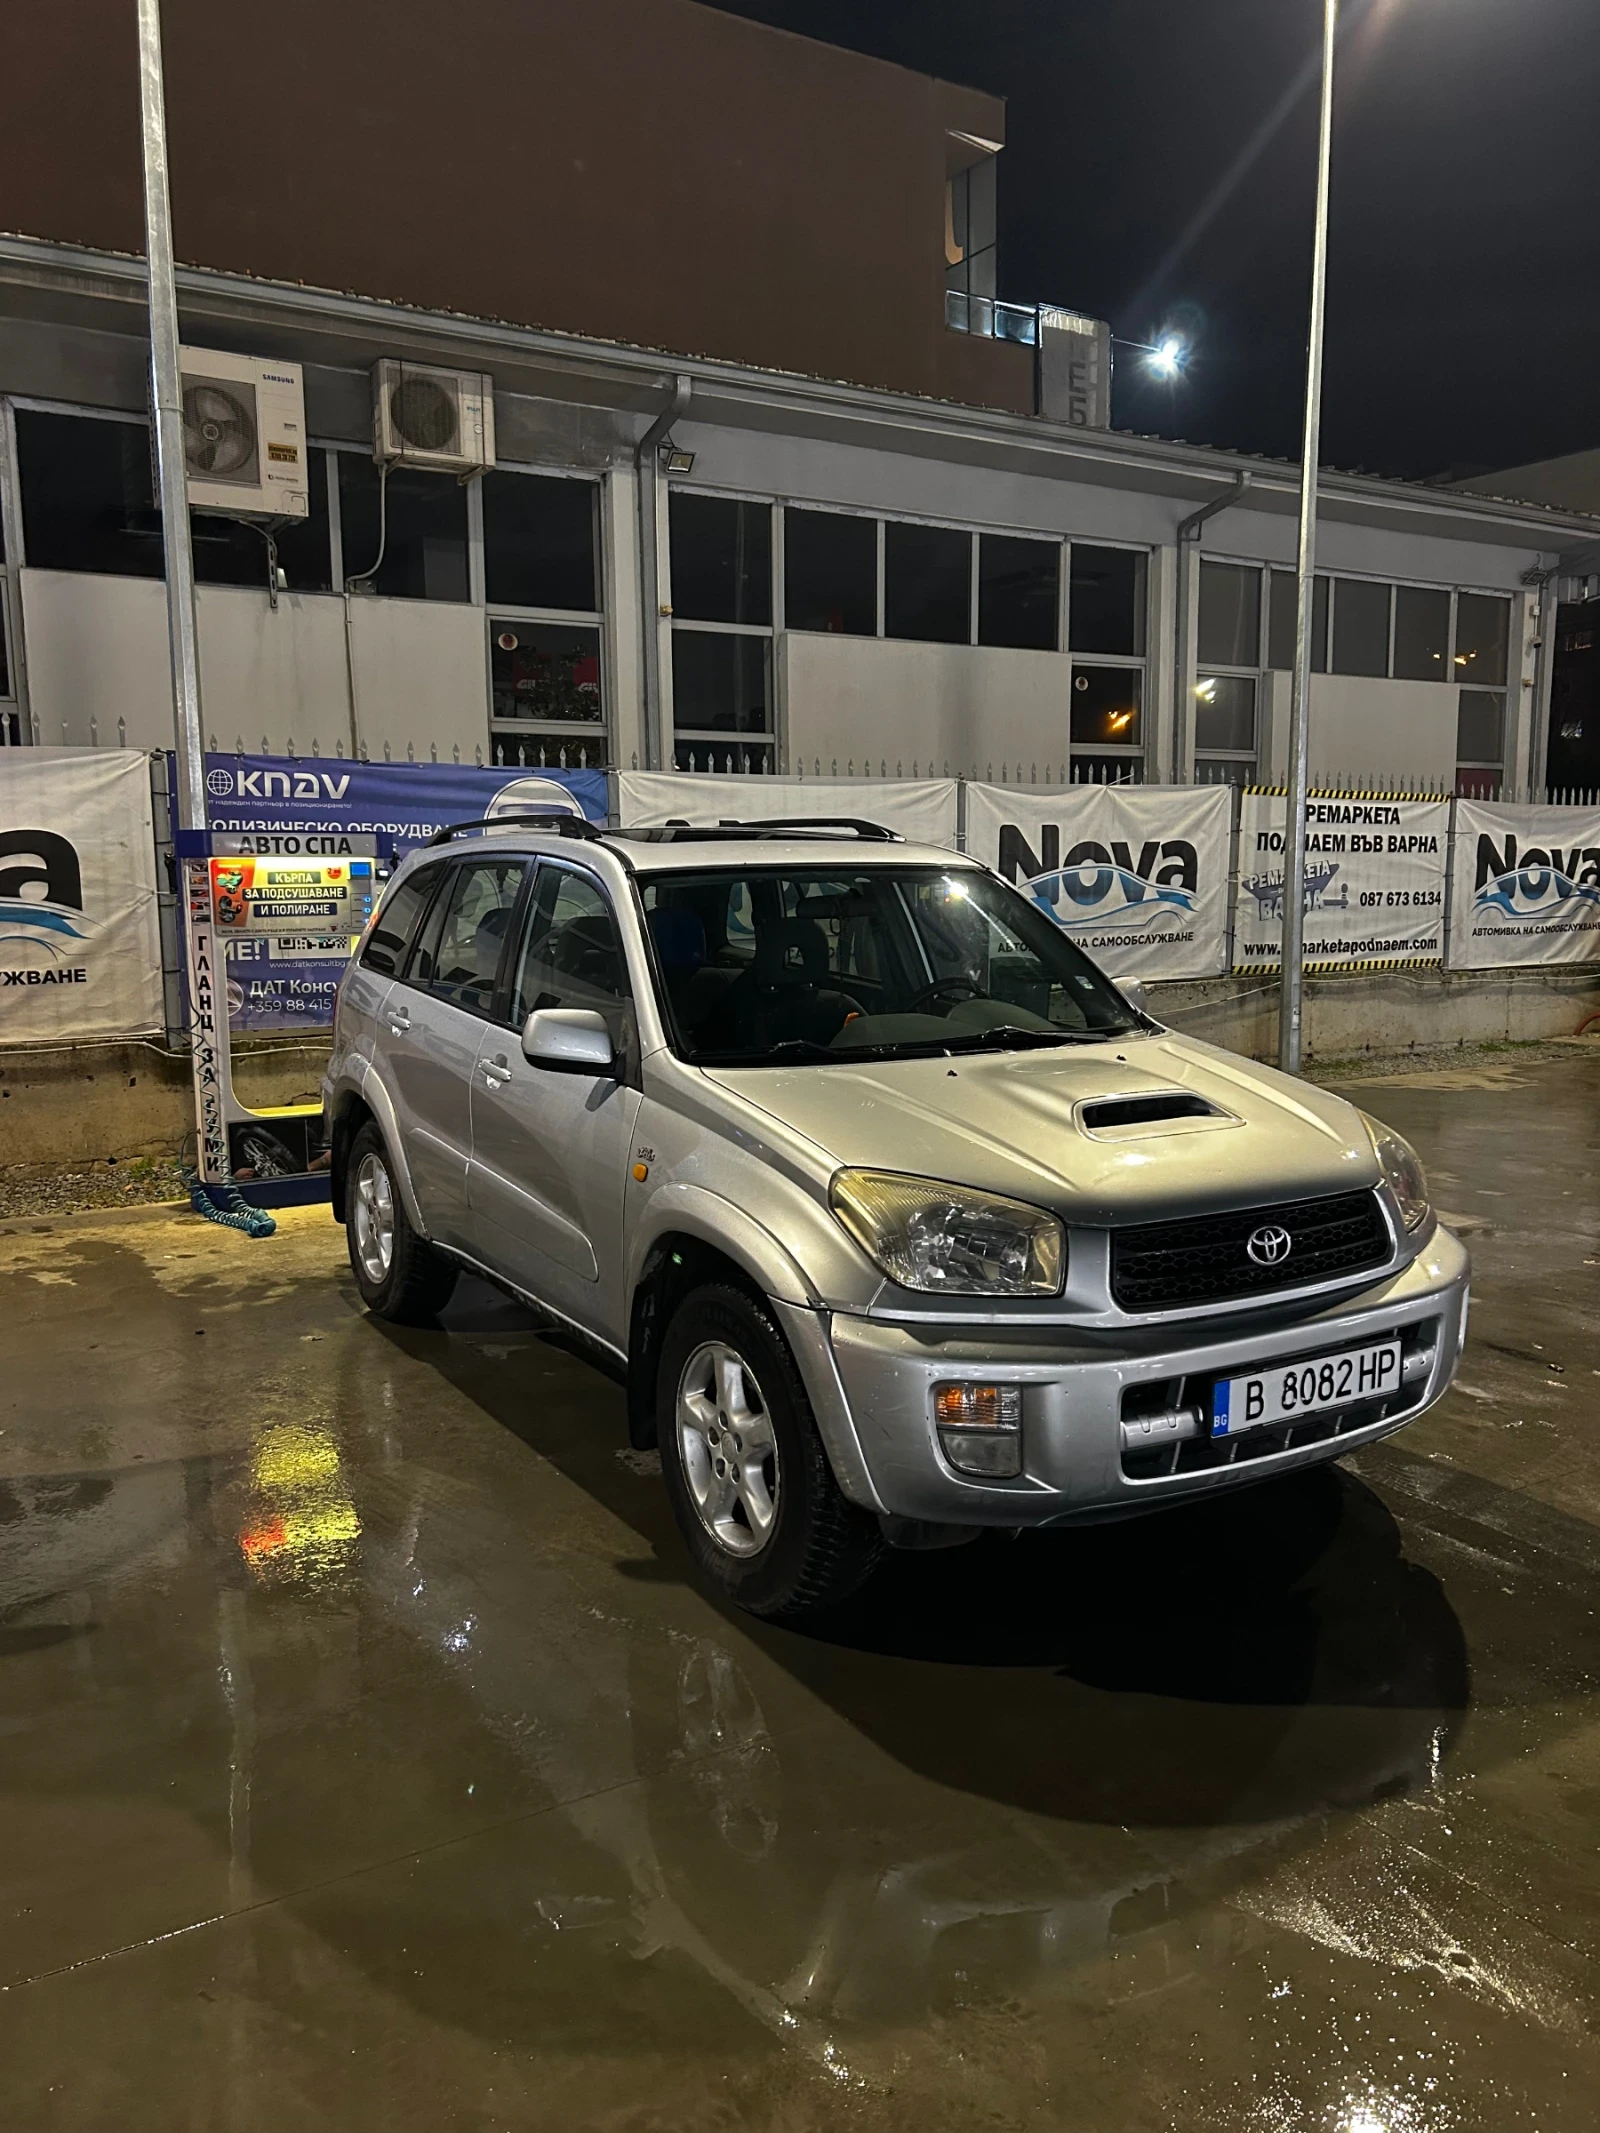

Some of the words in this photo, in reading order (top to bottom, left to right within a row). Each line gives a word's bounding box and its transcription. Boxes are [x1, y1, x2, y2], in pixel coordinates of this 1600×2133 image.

[262, 373, 295, 384] SAMSUNG
[238, 837, 300, 855] АВТО
[305, 837, 352, 854] СПА
[1351, 835, 1383, 853] ВЪВ
[1388, 835, 1438, 853] ВАРНА
[998, 824, 1198, 906] Nova
[1475, 833, 1600, 900] Nova
[275, 873, 313, 884] КЪРПА
[245, 888, 259, 899] ЗА
[263, 887, 344, 900] ПОДСУШАВАНЕ
[1360, 892, 1382, 906] 087
[1387, 891, 1410, 906] 673
[1413, 891, 1442, 905] 6134
[260, 906, 269, 915] И
[272, 904, 331, 915] ПОЛИРАНЕ
[1472, 927, 1521, 937] АВТОМИВКА
[1523, 926, 1534, 935] НА
[1092, 931, 1194, 948] САМООБСЛУЖВАНЕ
[250, 980, 285, 998] ДАТ
[247, 1001, 282, 1013] +359
[286, 1001, 305, 1011] 88
[308, 998, 332, 1010] 415
[1245, 1380, 1265, 1421] B
[1213, 1414, 1228, 1428] BG
